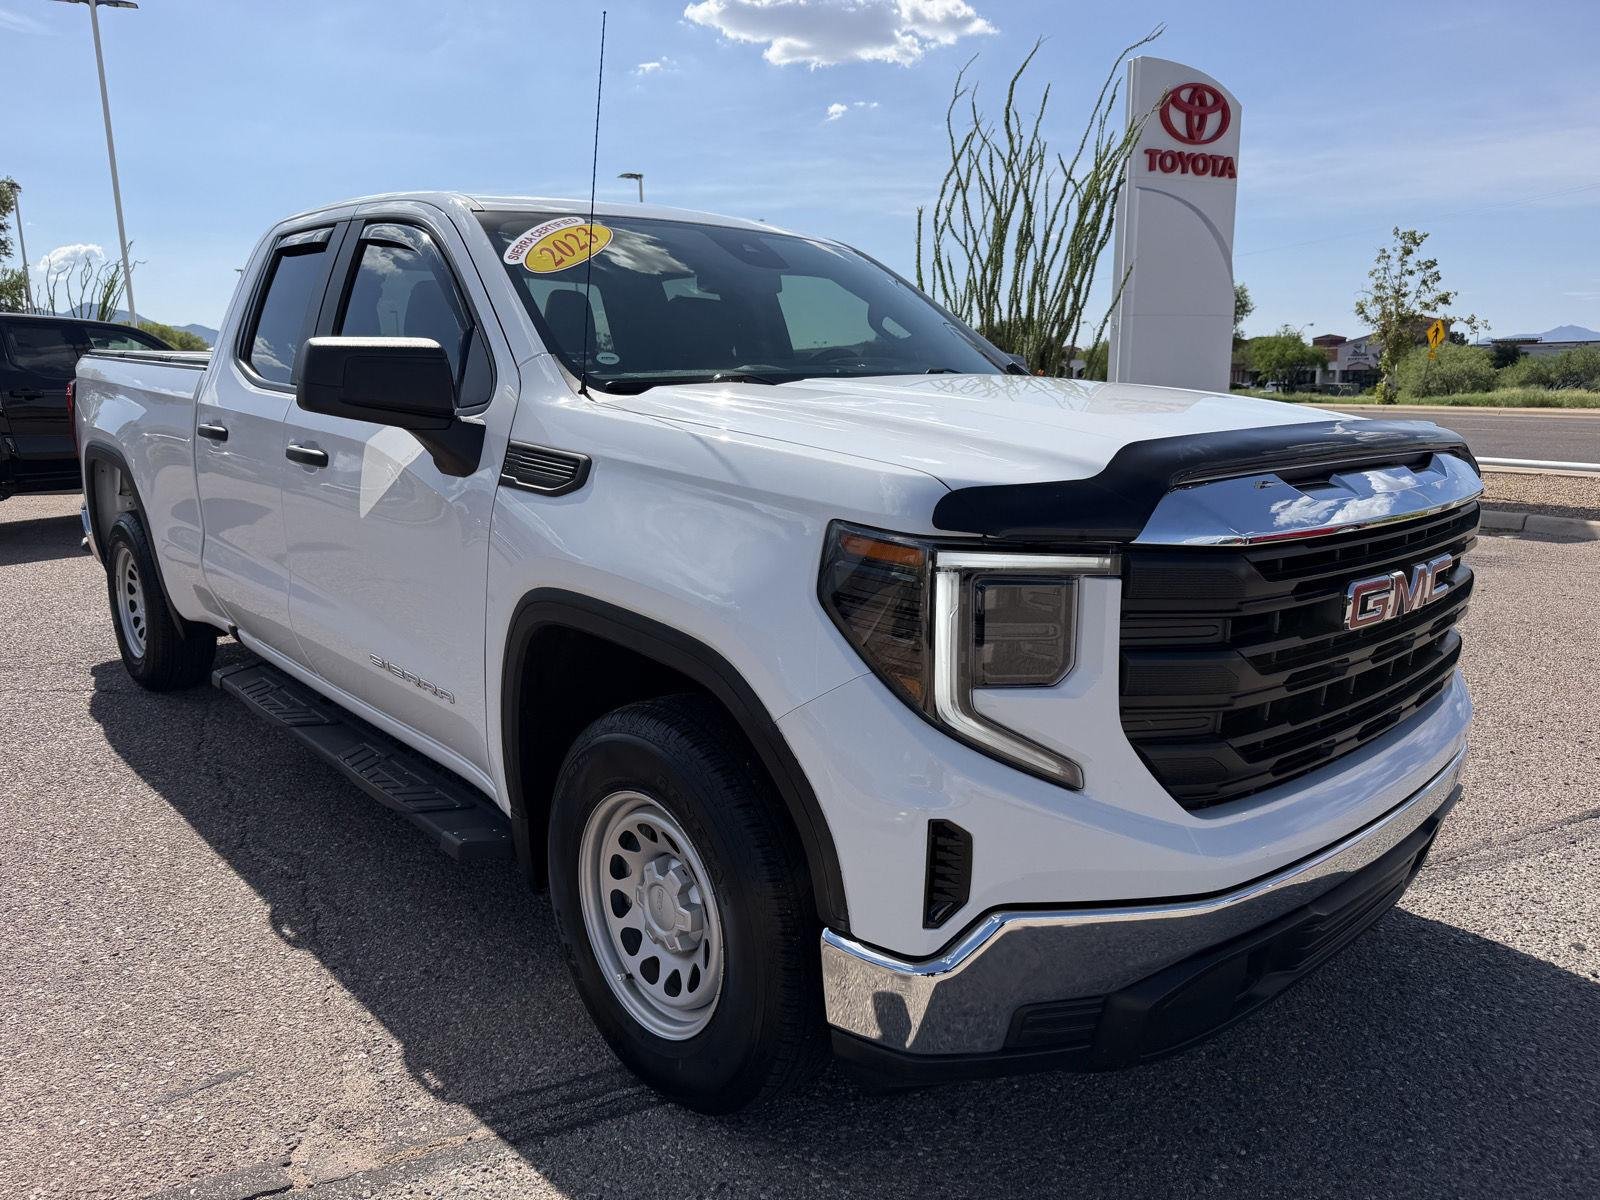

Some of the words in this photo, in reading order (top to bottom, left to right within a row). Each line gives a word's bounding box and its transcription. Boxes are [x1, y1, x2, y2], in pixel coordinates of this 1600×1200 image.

[1144, 148, 1237, 179] TOYOTA
[508, 235, 536, 261] SIERRA
[530, 218, 580, 239] CERTIFIED
[540, 227, 599, 267] 2023
[1344, 553, 1453, 631] GMC
[368, 652, 456, 705] SIERRA
